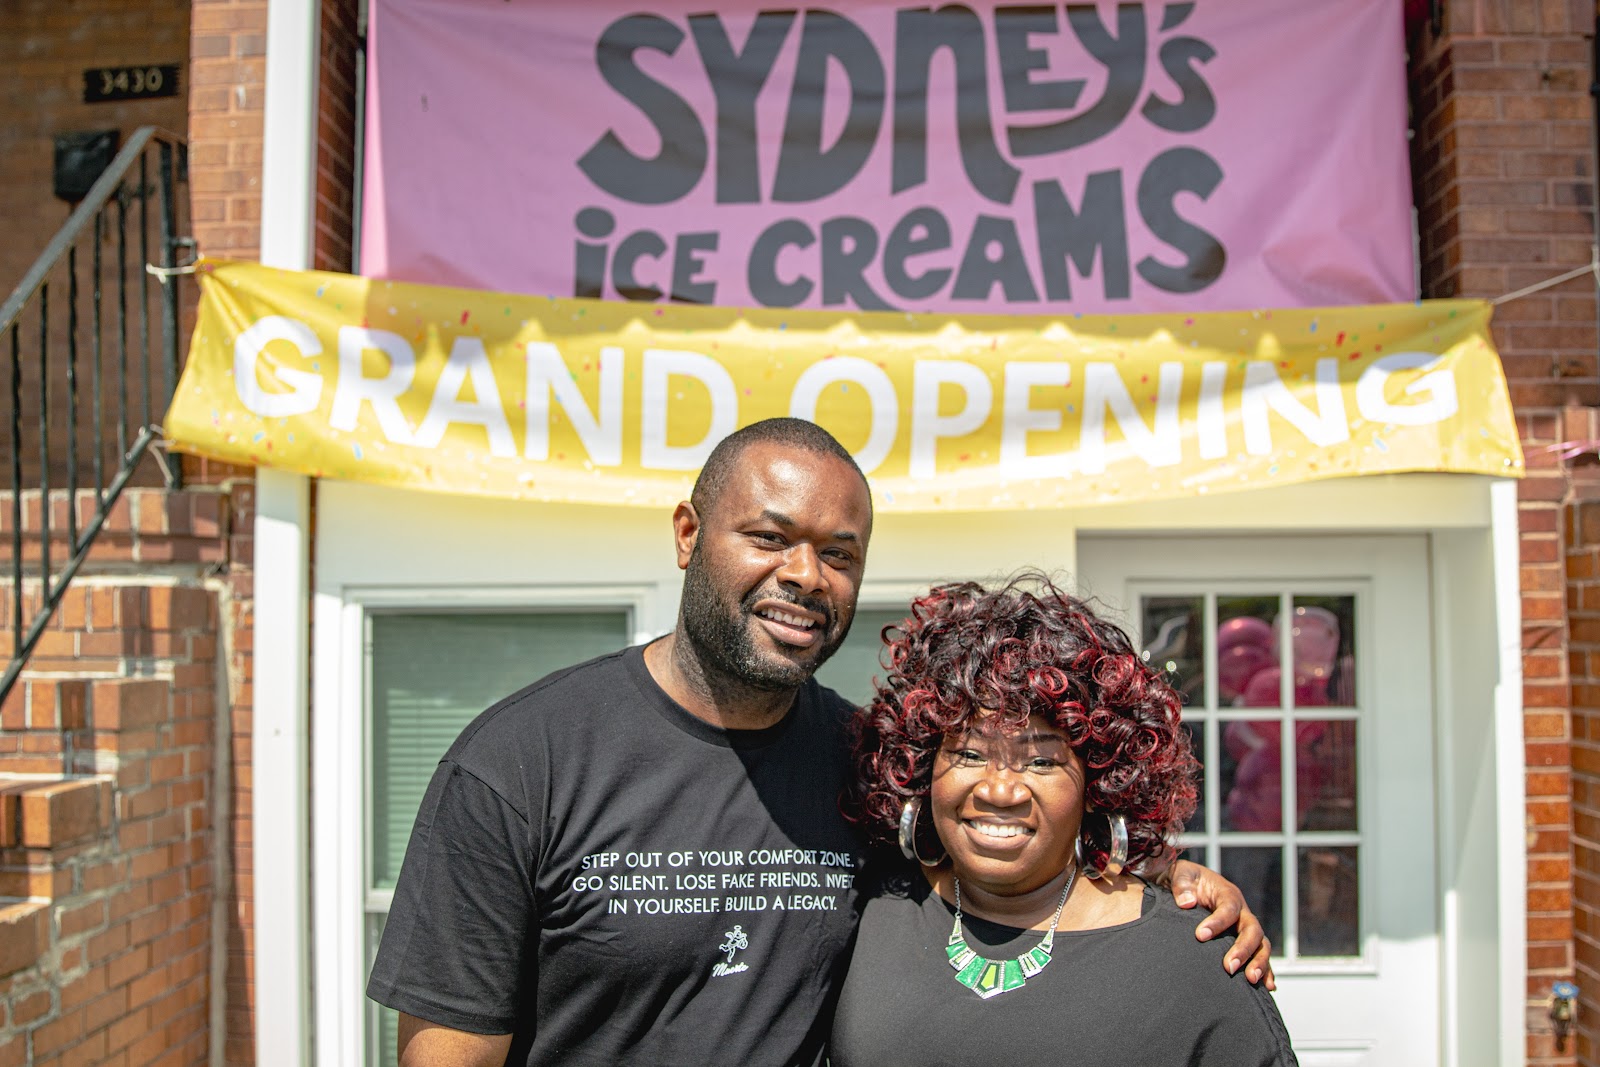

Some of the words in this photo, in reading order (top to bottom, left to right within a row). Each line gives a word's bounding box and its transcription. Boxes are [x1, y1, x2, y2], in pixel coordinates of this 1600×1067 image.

[100, 67, 163, 95] 3430
[233, 315, 738, 471] GRAND
[789, 351, 1458, 479] OPENING
[581, 852, 620, 870] STEP
[625, 852, 662, 868] OUT
[667, 851, 694, 867] OF
[698, 850, 745, 867] YOUR
[748, 849, 817, 865] COMFORT
[819, 850, 855, 868] ZONE.
[572, 875, 603, 892] GO
[608, 874, 669, 891] SILENT.
[675, 874, 716, 891] LOSE
[721, 873, 755, 889] FAKE
[760, 871, 821, 888] FRIENDS.
[608, 898, 628, 915] IN
[633, 897, 720, 915] YOURSELF.
[724, 894, 768, 912] BUILD
[771, 894, 785, 911] A
[787, 894, 838, 911] LEGACY.
